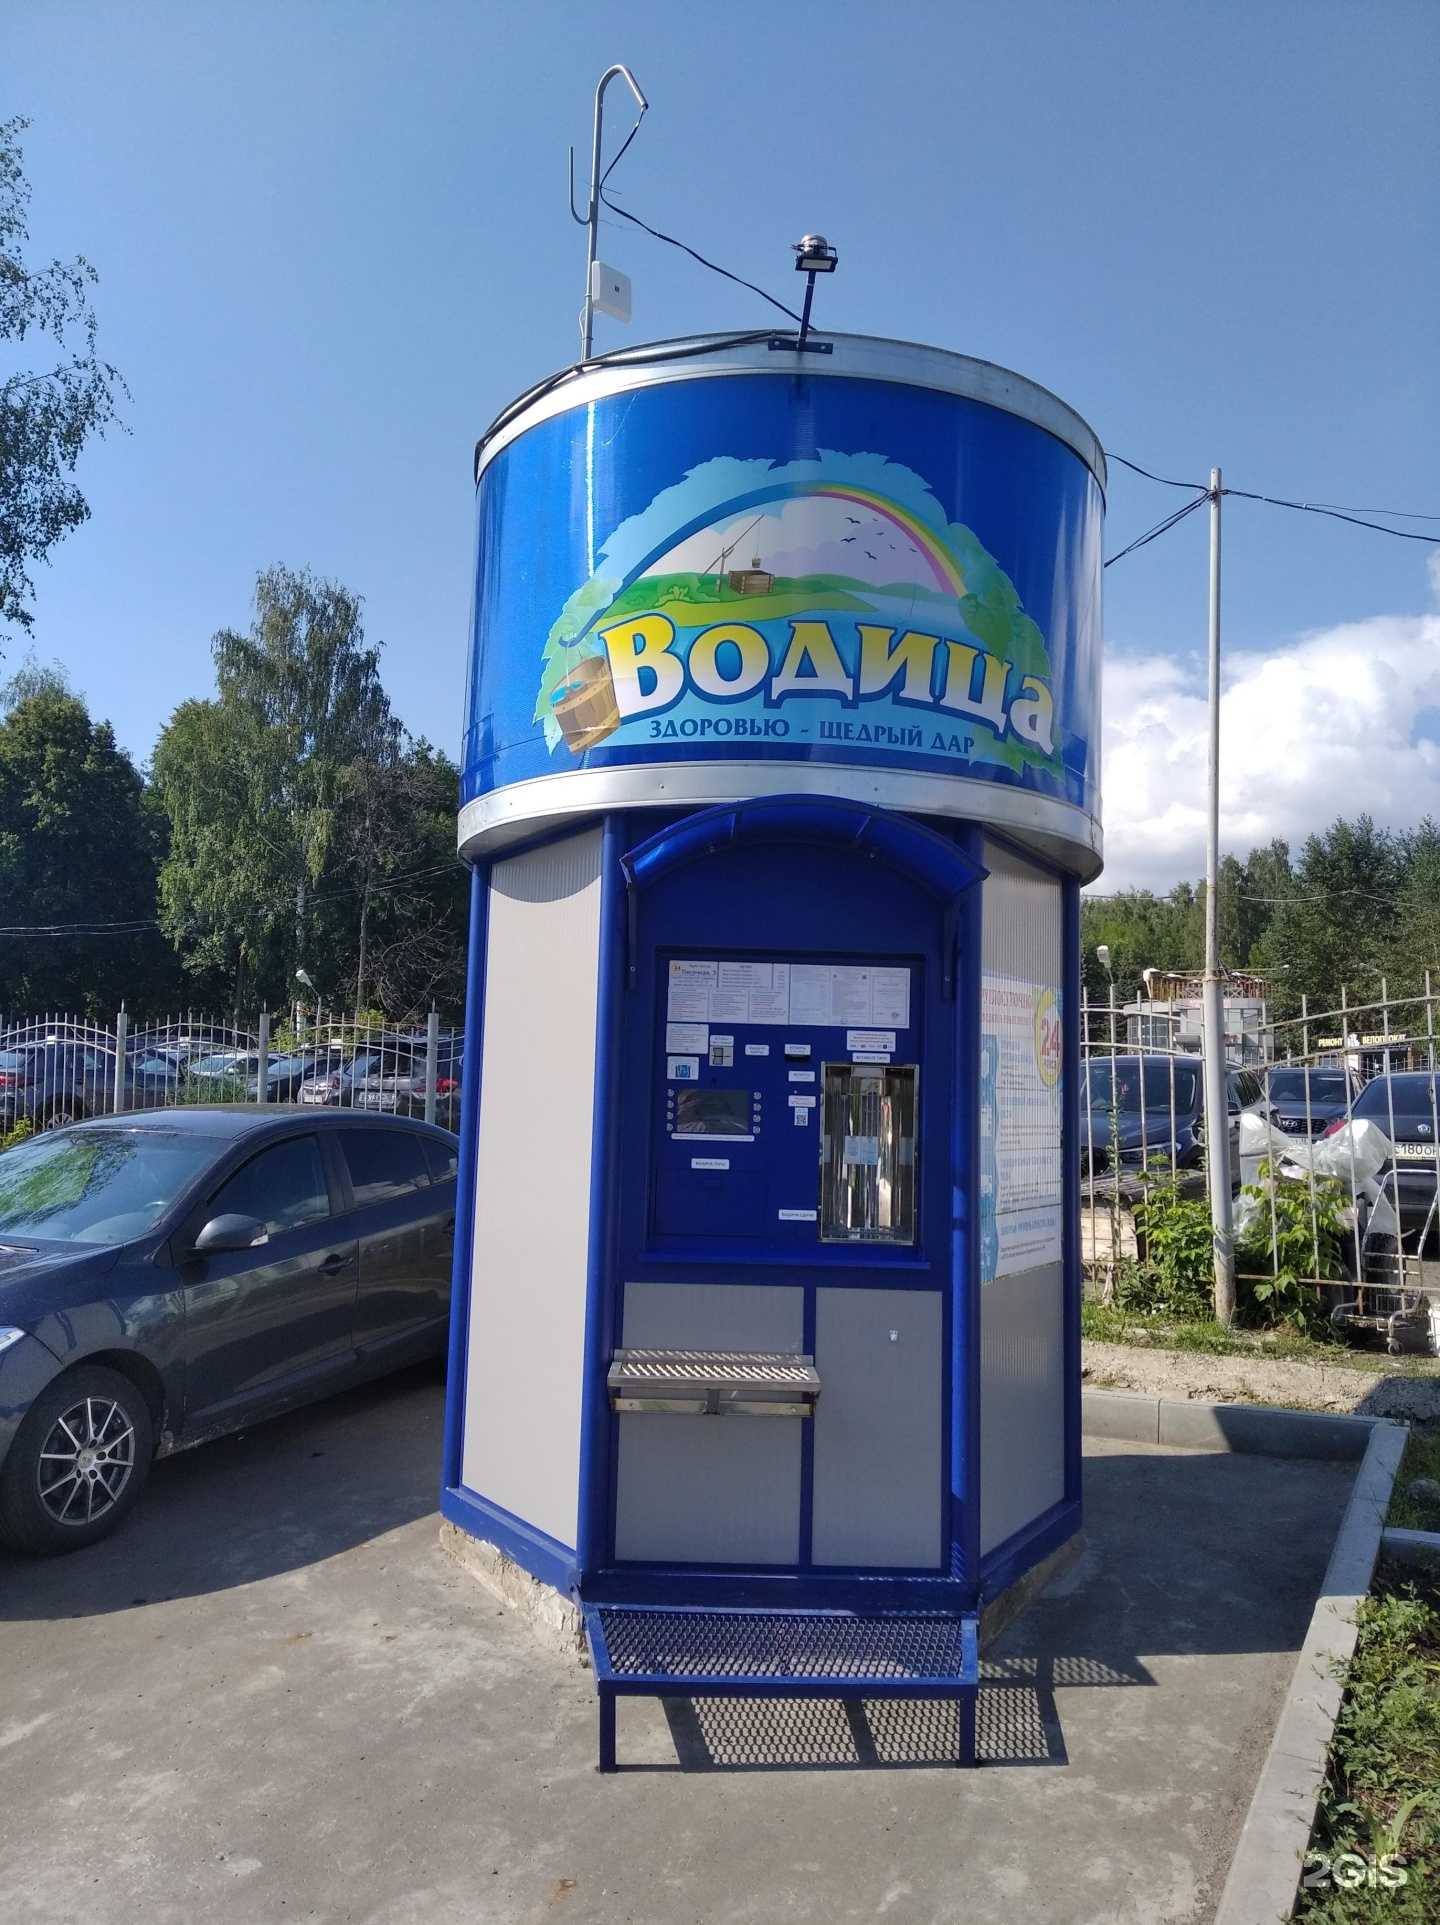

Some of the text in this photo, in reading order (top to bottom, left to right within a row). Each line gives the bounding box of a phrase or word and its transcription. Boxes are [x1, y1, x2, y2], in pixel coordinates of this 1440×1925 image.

[650, 718, 790, 738] ЗДОРОВЬЮ
[820, 721, 923, 747] ЩЕДРЫЙ
[930, 732, 975, 753] ДАР
[1041, 1018, 1060, 1057] 24
[1318, 1034, 1407, 1047] РЕМОНТ ВЕЛОПОКАТ
